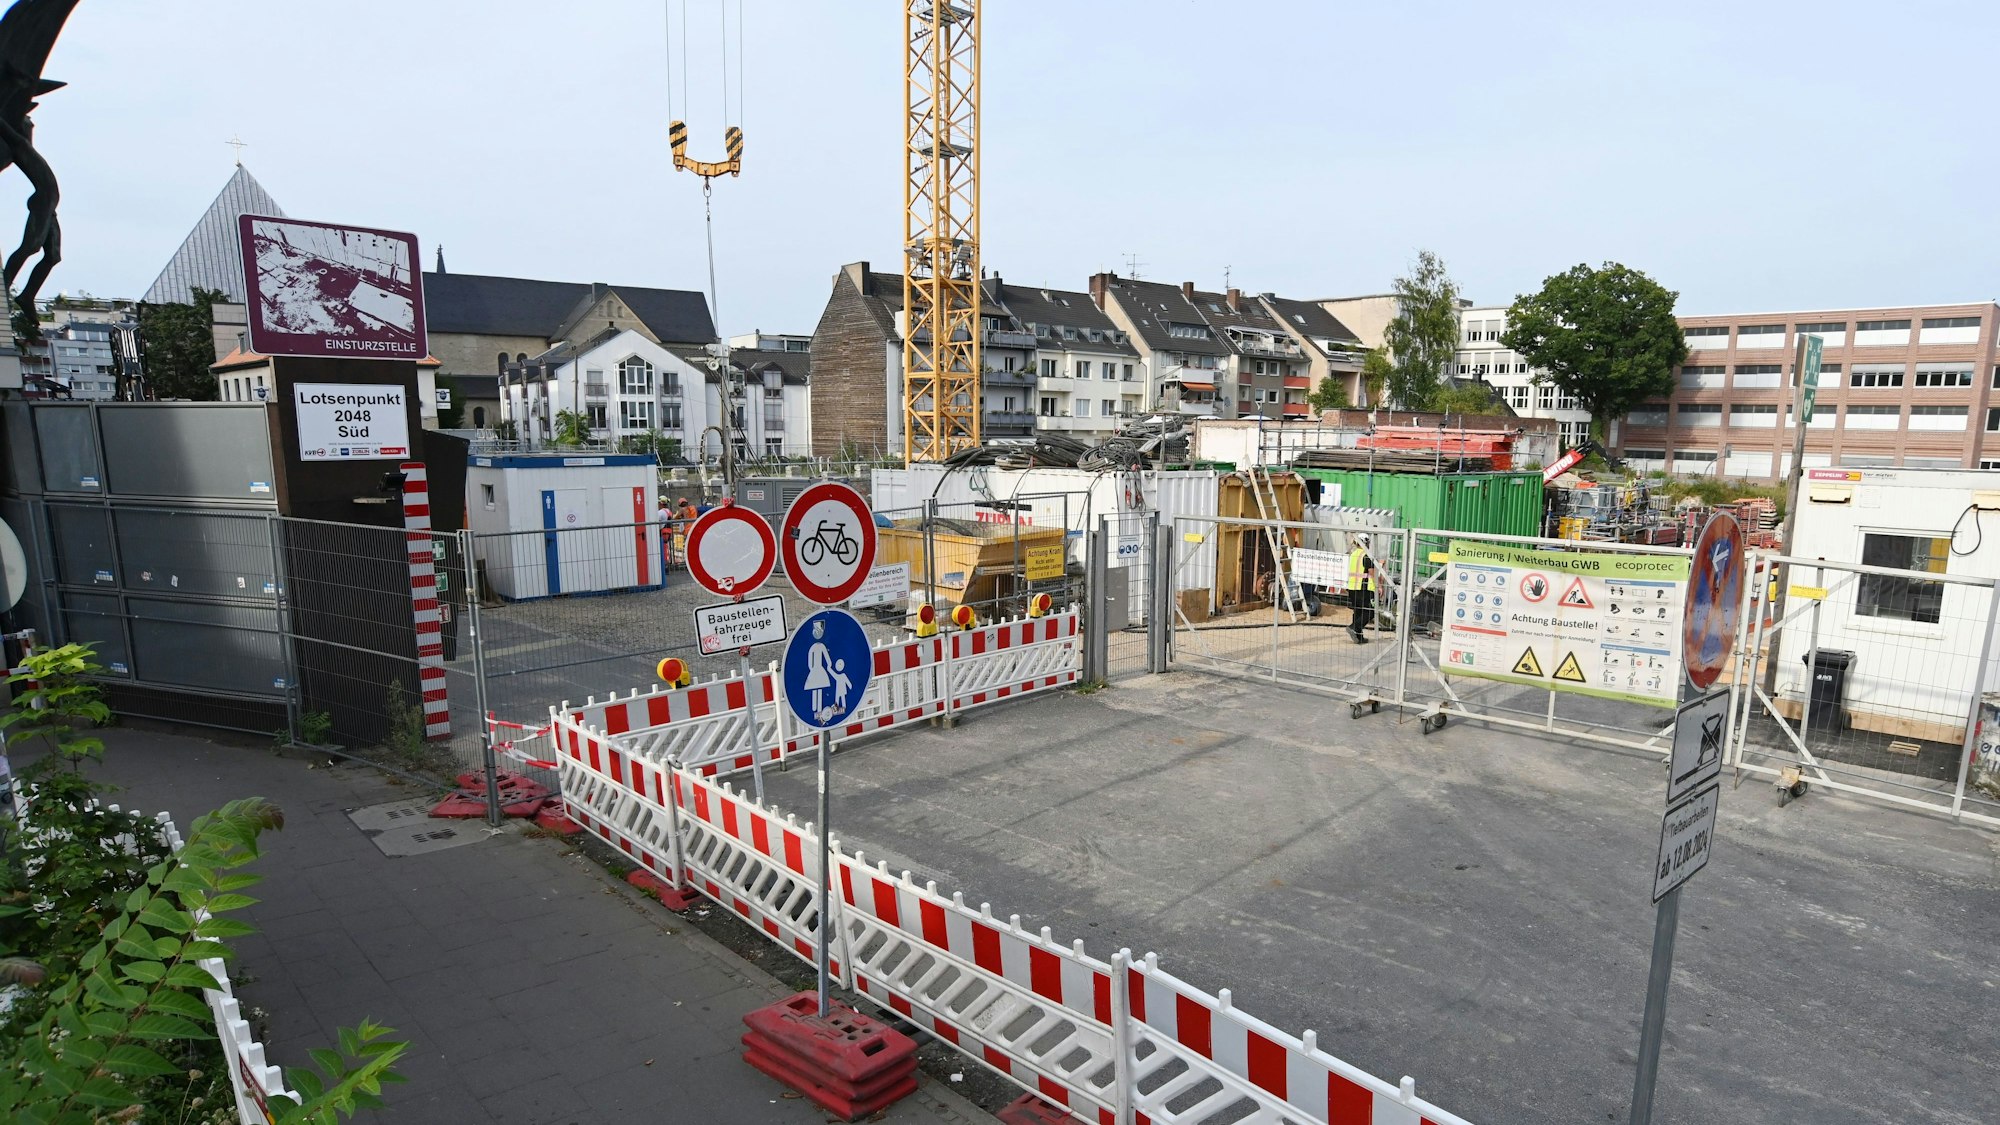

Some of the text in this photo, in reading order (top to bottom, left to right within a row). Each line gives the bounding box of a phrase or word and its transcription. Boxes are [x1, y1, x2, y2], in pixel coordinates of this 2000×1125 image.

[326, 339, 416, 352] EINSTURZSTELLE
[300, 392, 401, 407] Lotsenpunkt
[335, 410, 371, 422] 2048
[338, 426, 369, 438] Süd
[1543, 454, 1574, 480] ANITOU
[1028, 549, 1048, 558] Achtung
[1297, 551, 1344, 564] Baustellenbereich
[1456, 547, 1600, 570] Sanierung / Weiterbau GWB
[1615, 561, 1674, 571] ecoprotec
[708, 607, 774, 624] Baustellen-
[1511, 613, 1598, 630] Achtung Baustelle!
[714, 619, 772, 635] fahrzeuge
[732, 631, 752, 644] frei
[1670, 806, 1709, 838] Tiefbauarbeiten
[1660, 853, 1671, 879] ab
